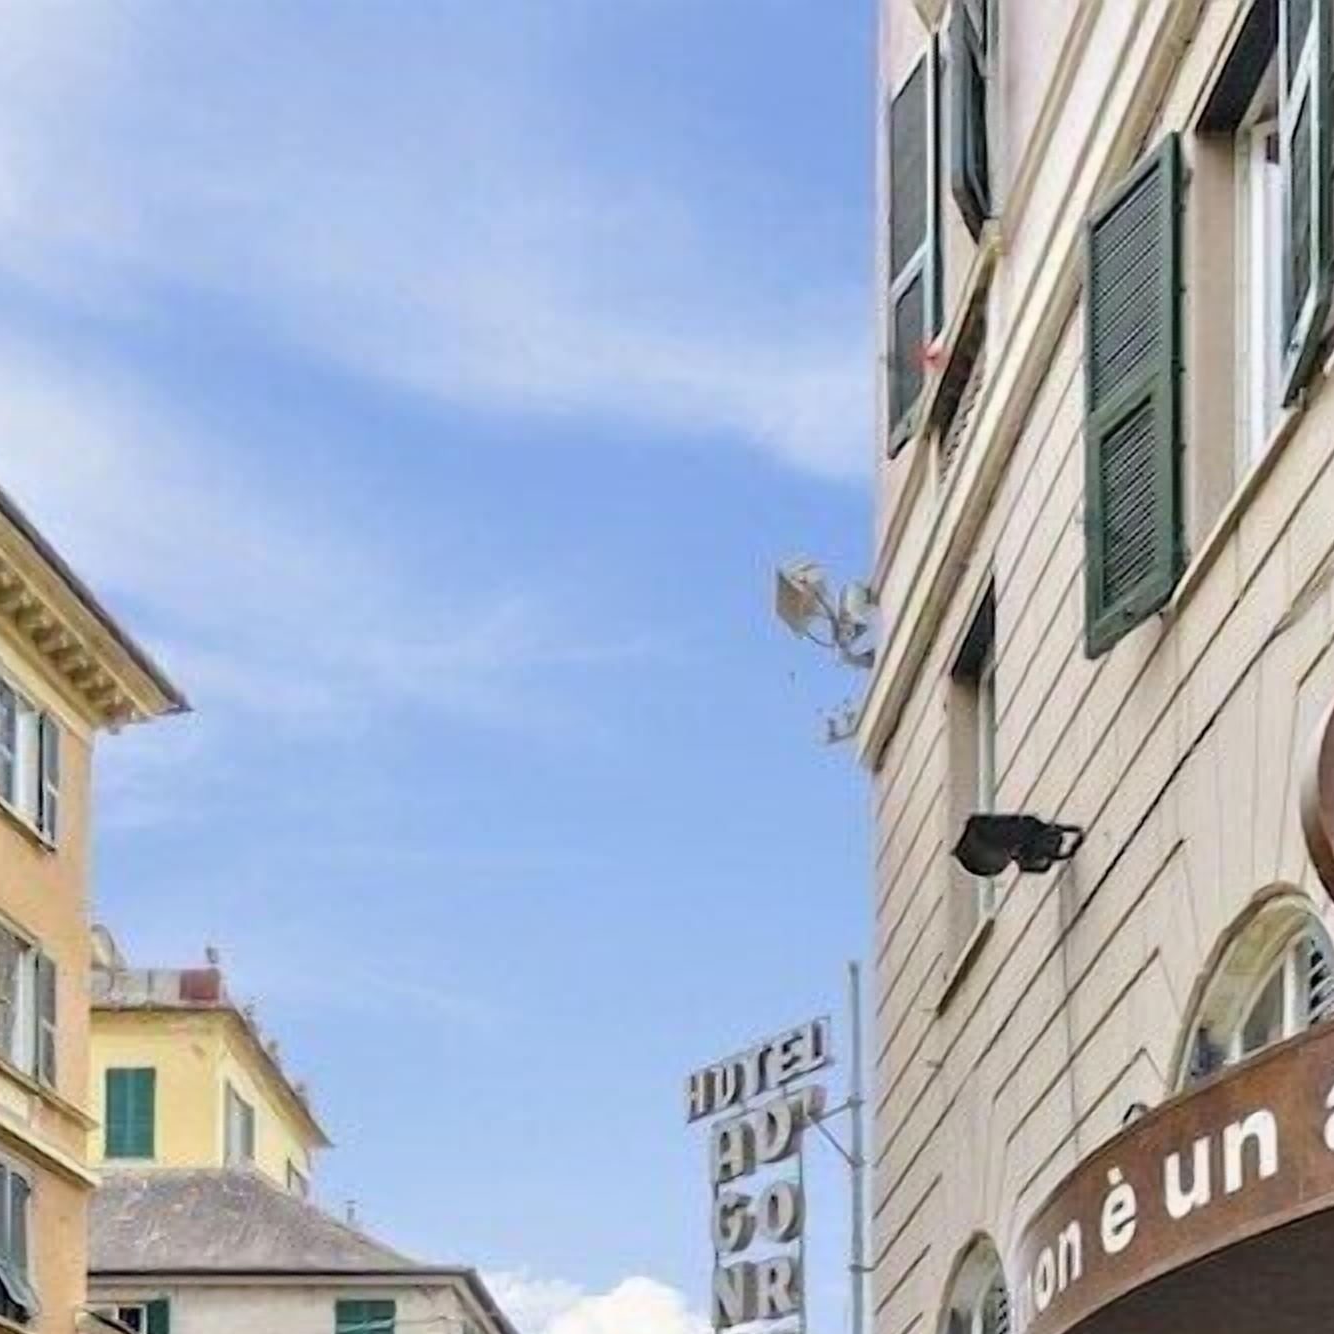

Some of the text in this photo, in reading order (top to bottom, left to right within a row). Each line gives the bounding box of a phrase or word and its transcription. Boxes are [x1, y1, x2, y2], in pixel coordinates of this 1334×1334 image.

[686, 1016, 831, 1123] HOTEL
[1027, 1220, 1082, 1321] on
[1101, 1165, 1137, 1254] è
[1163, 1107, 1278, 1218] un
